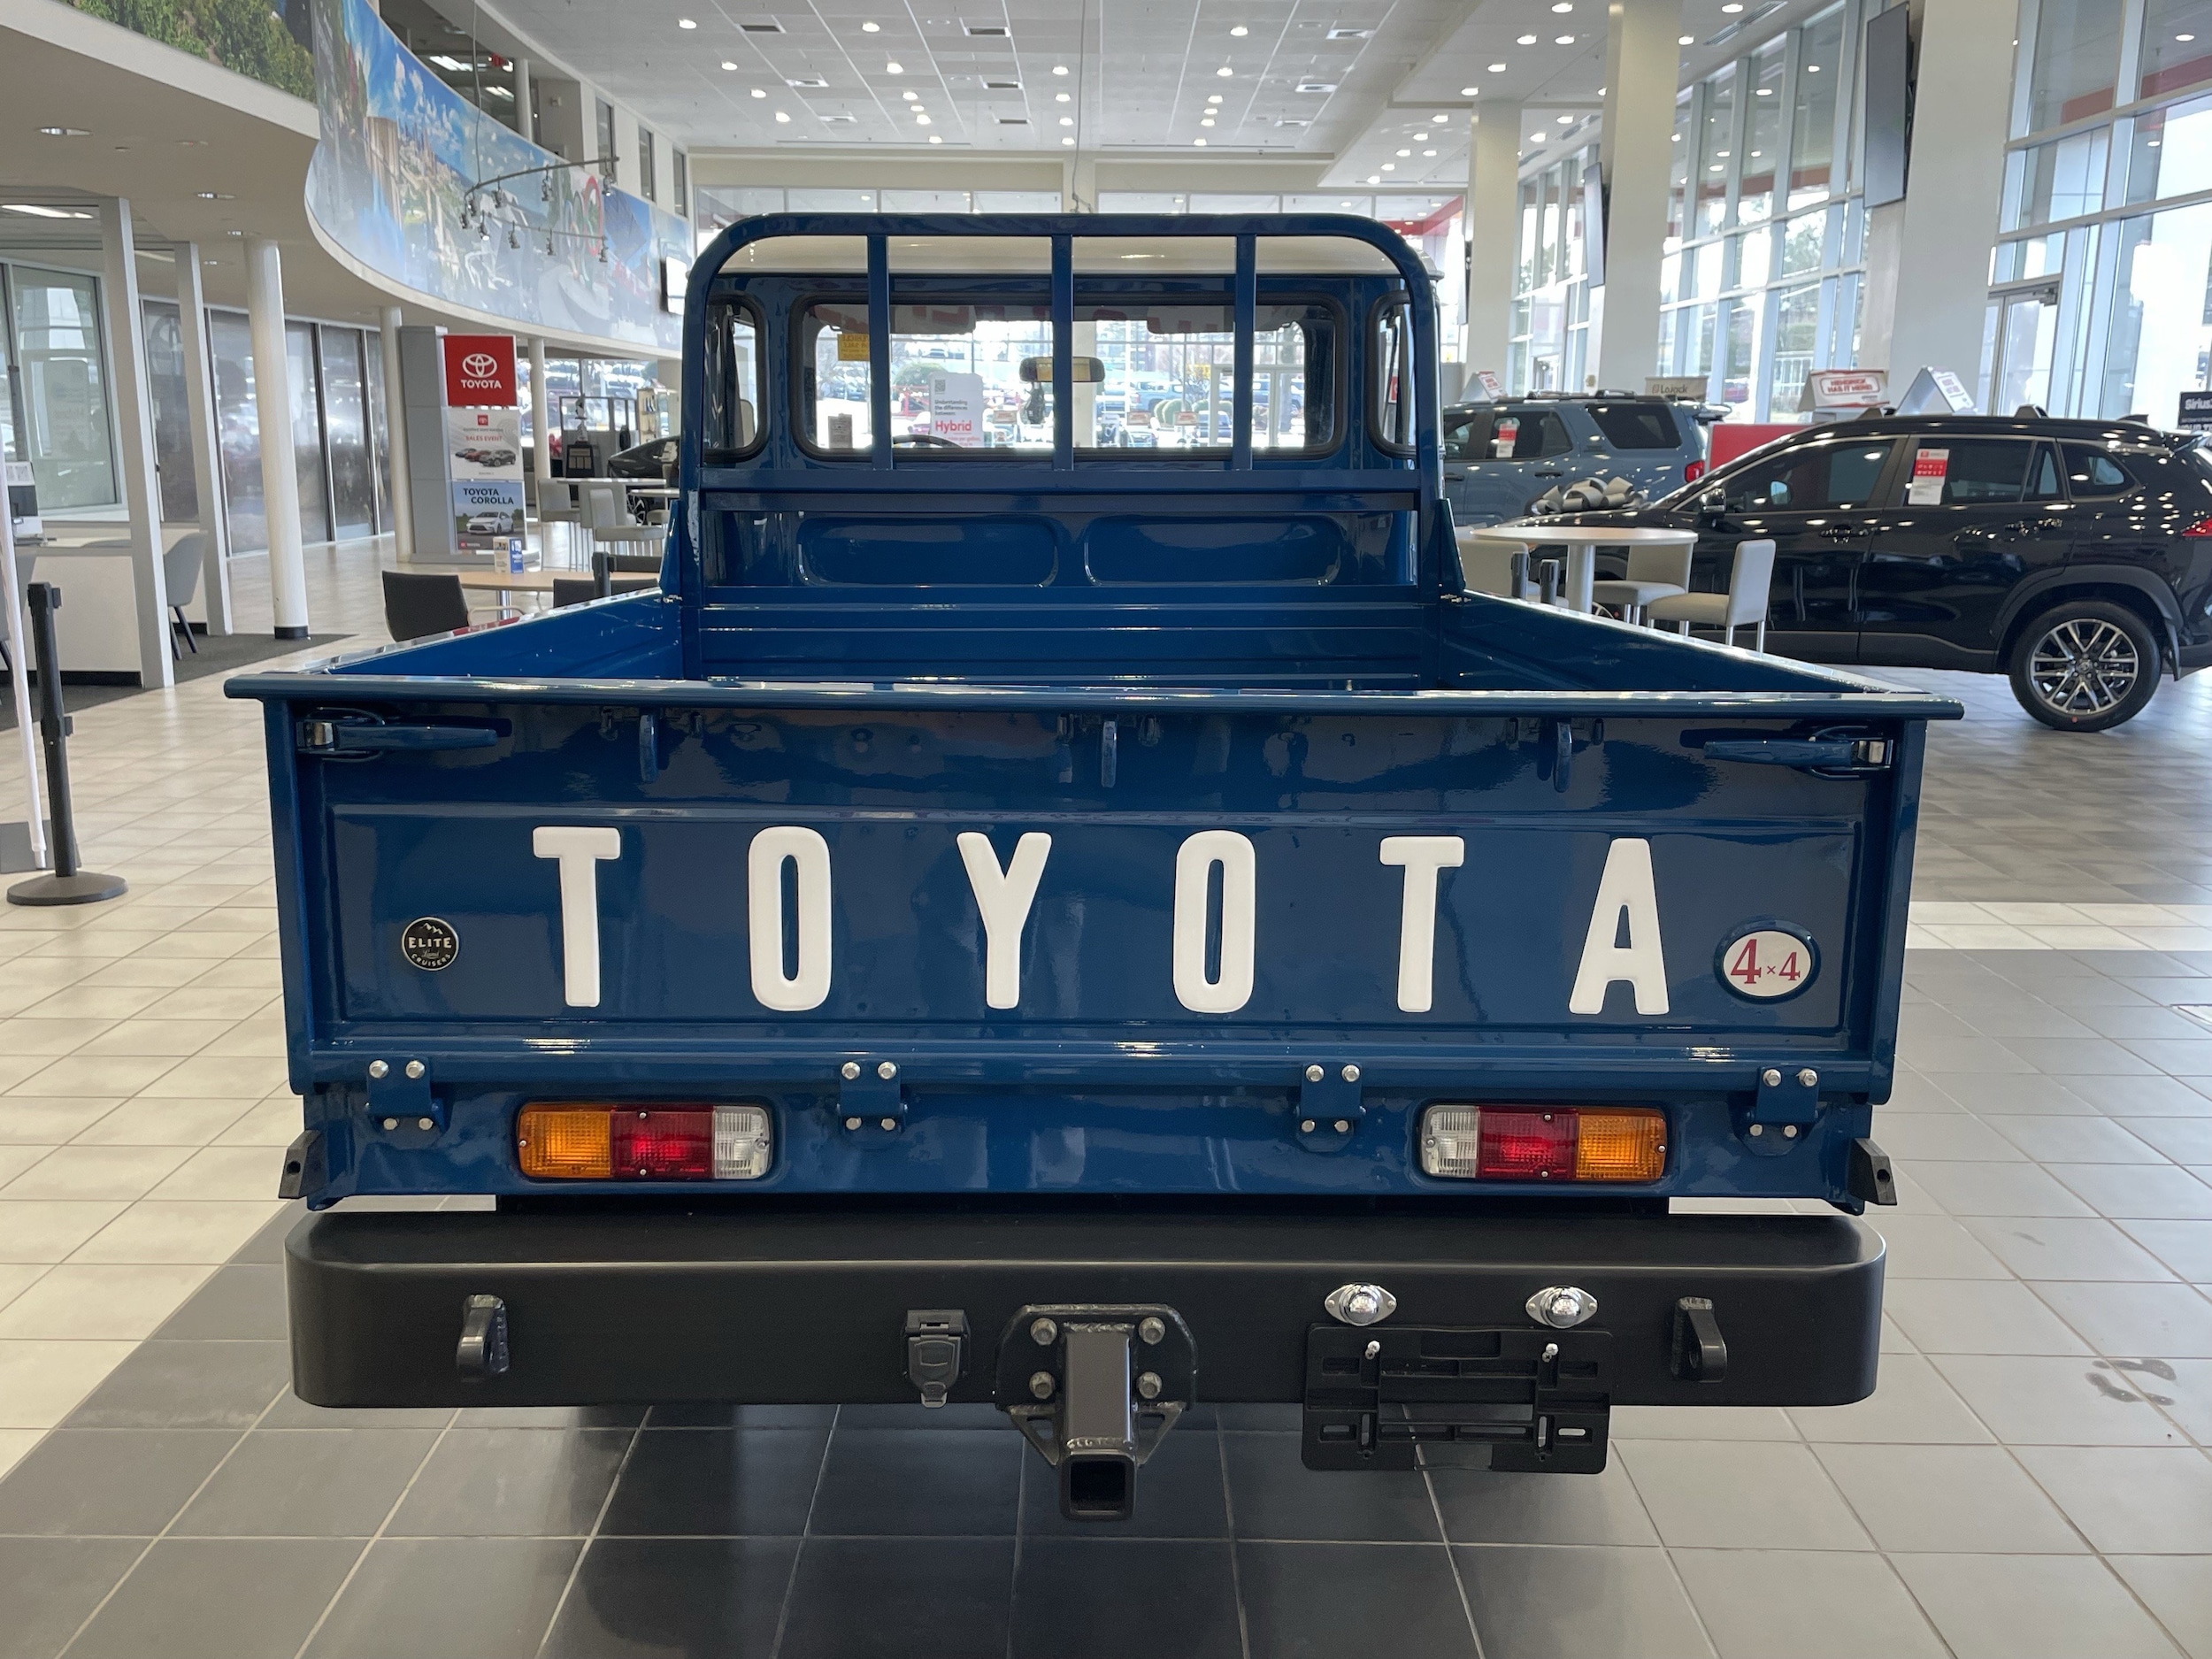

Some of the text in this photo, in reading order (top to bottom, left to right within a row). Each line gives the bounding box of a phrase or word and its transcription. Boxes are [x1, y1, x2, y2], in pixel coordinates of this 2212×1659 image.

[460, 380, 503, 389] TOYOTA
[935, 419, 972, 434] Hybrid
[533, 826, 1670, 1015] TOYOTA
[408, 936, 452, 949] ELITE
[411, 953, 451, 967] CRUISERS
